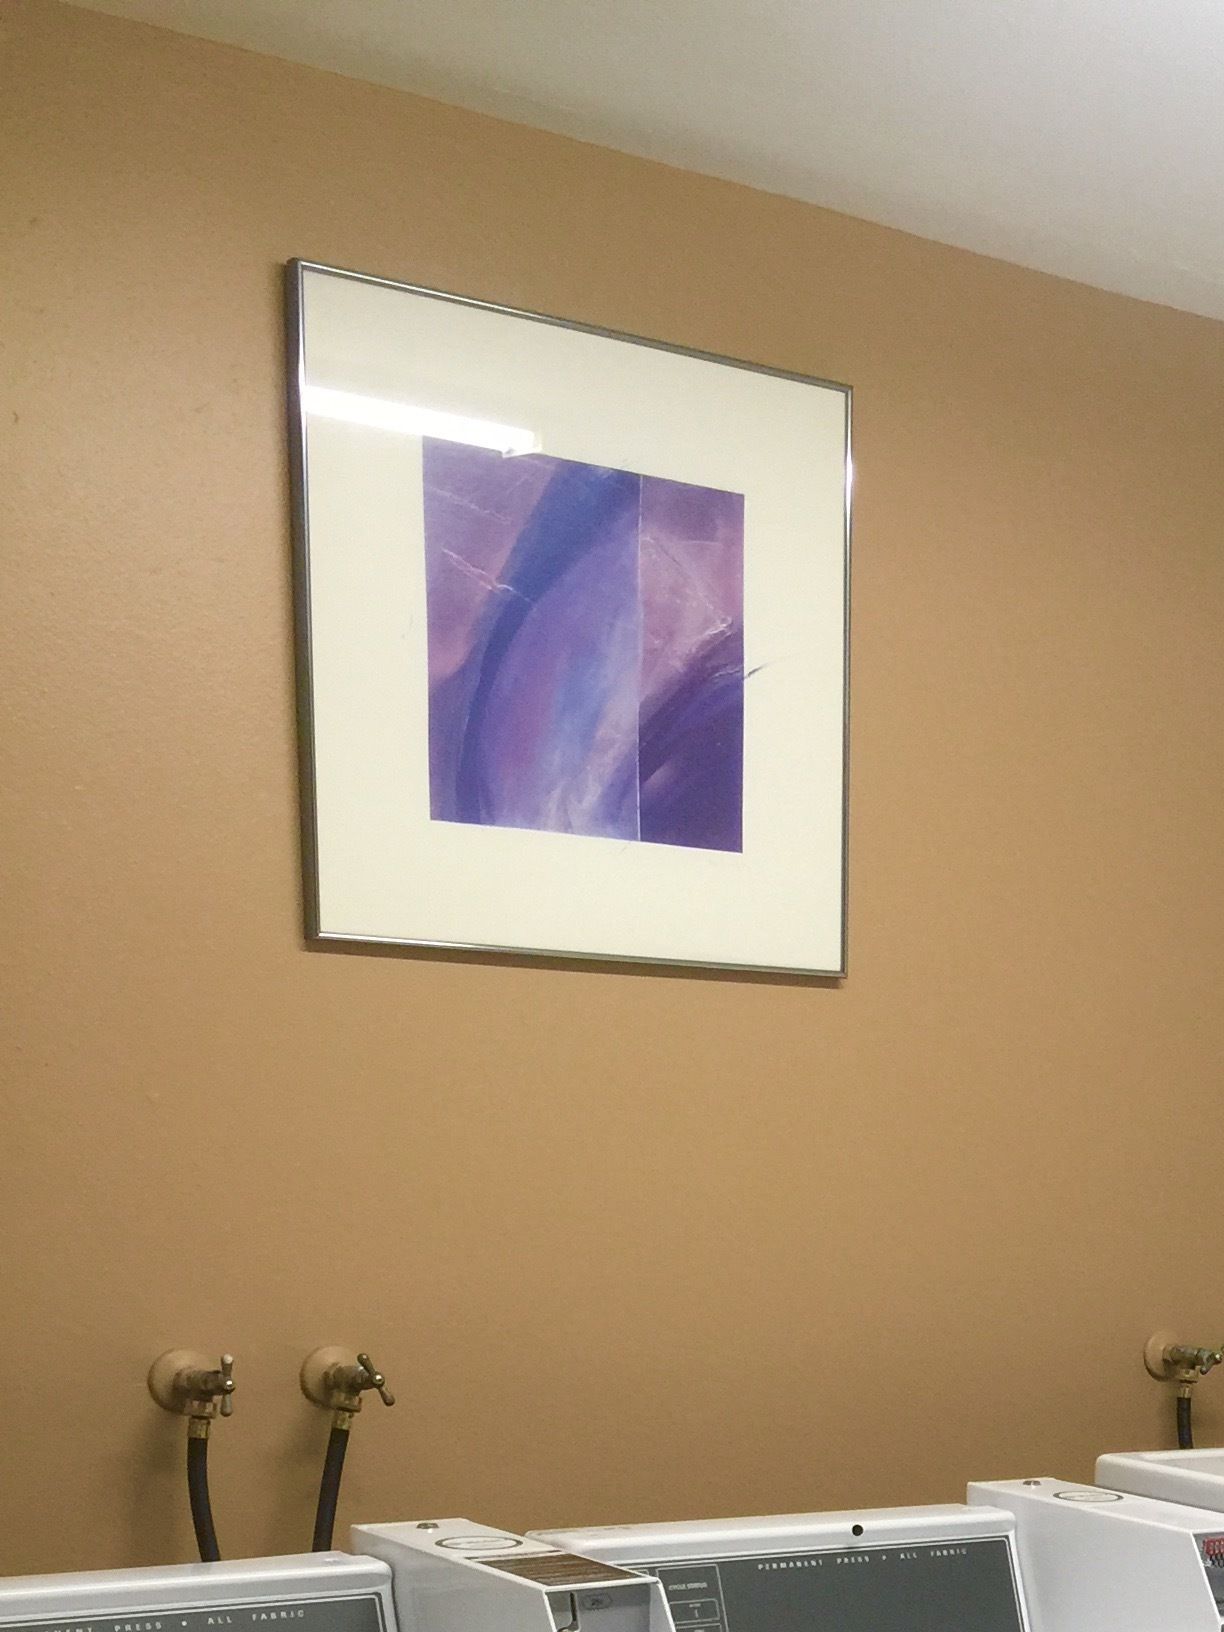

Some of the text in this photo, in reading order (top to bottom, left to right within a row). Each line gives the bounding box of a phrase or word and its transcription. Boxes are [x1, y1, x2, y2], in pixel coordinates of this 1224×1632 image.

[758, 1559, 823, 1571] PERMANENT
[836, 1555, 870, 1565] PRESS
[930, 1548, 967, 1558] FABRIC
[114, 1621, 163, 1632] PRESS
[207, 1615, 233, 1625] ALL
[252, 1609, 305, 1621] FABRIC
